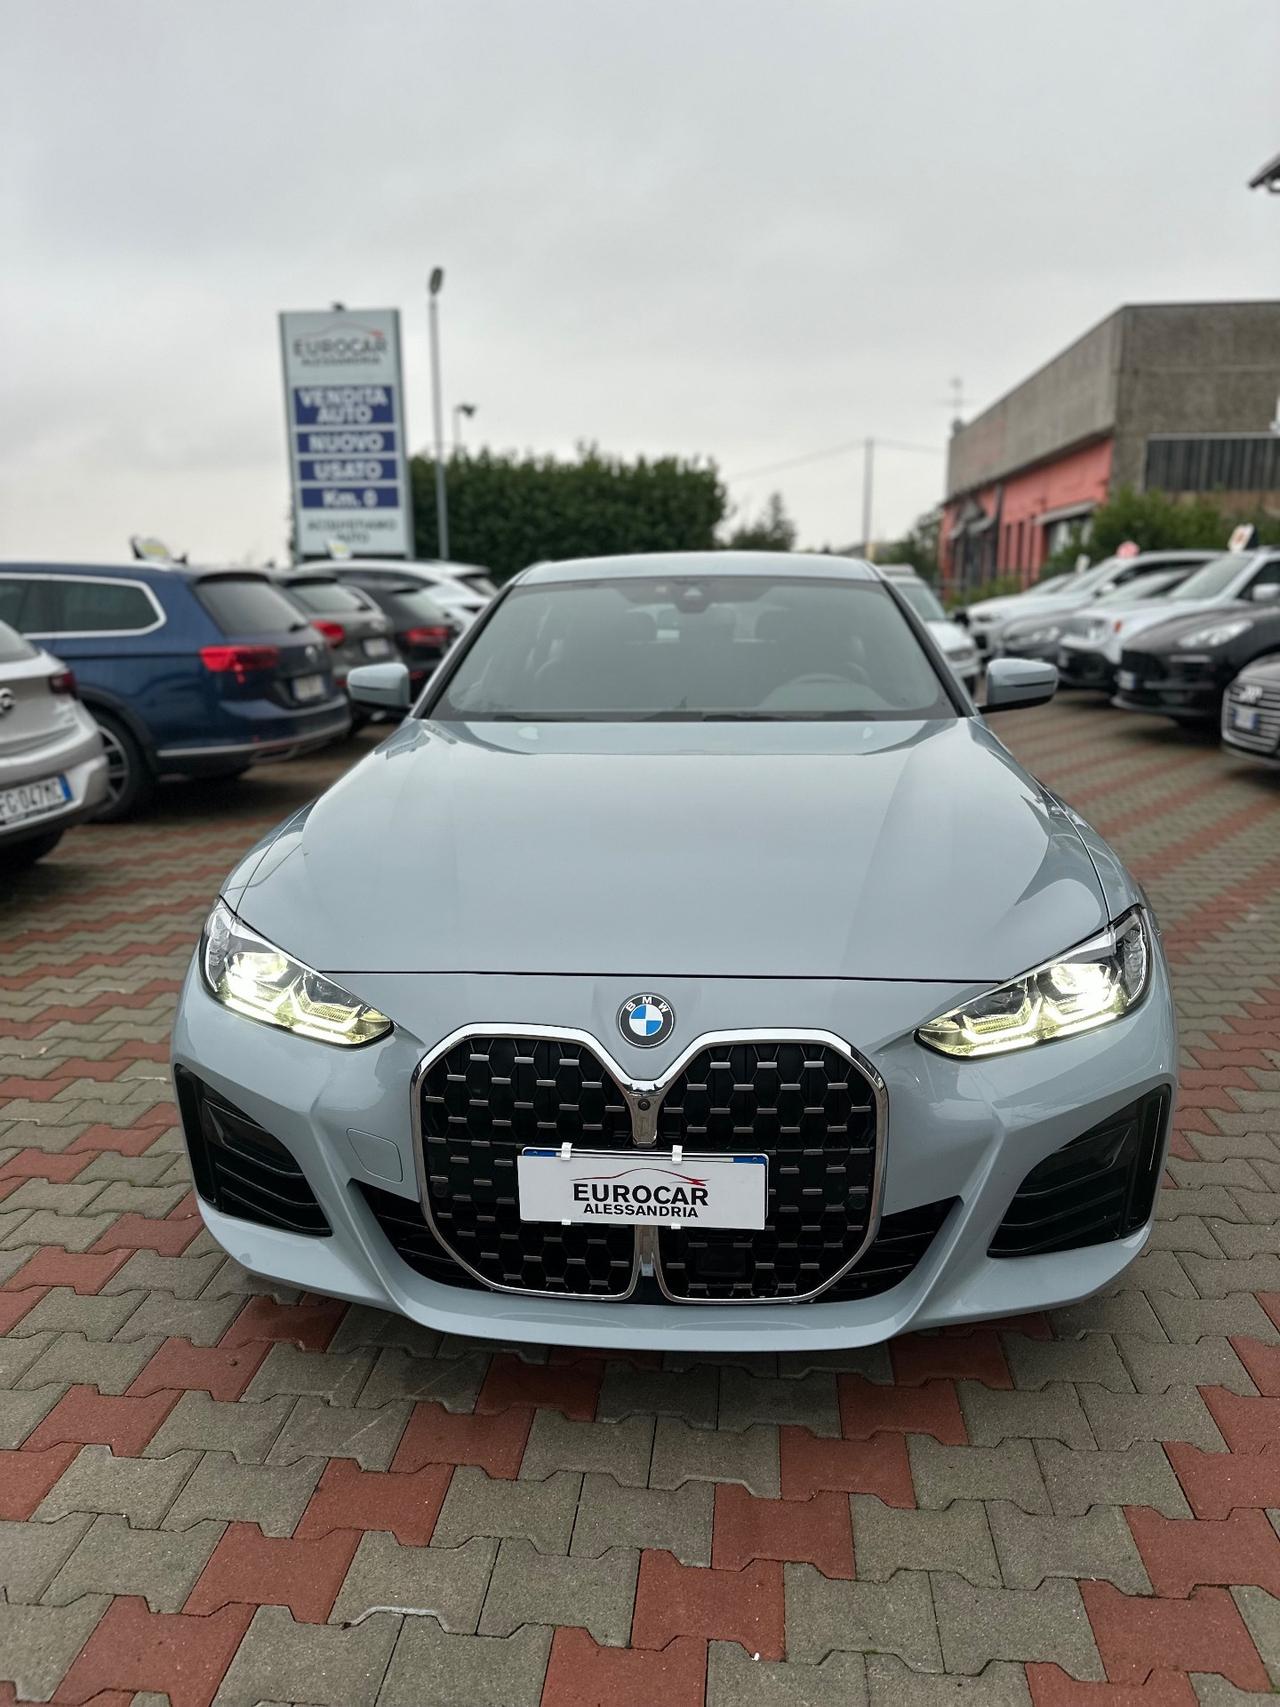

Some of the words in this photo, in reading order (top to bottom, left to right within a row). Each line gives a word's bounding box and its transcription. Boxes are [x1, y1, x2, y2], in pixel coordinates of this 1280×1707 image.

[294, 337, 387, 356] EUROCAR
[298, 387, 388, 406] VENDITA
[317, 405, 373, 423] AUTO
[309, 433, 384, 452] NUOVO
[313, 460, 383, 480] USATO
[625, 996, 669, 1013] BMW
[573, 1183, 709, 1206] EUROCAR
[583, 1203, 699, 1218] ALESSANDRIA
